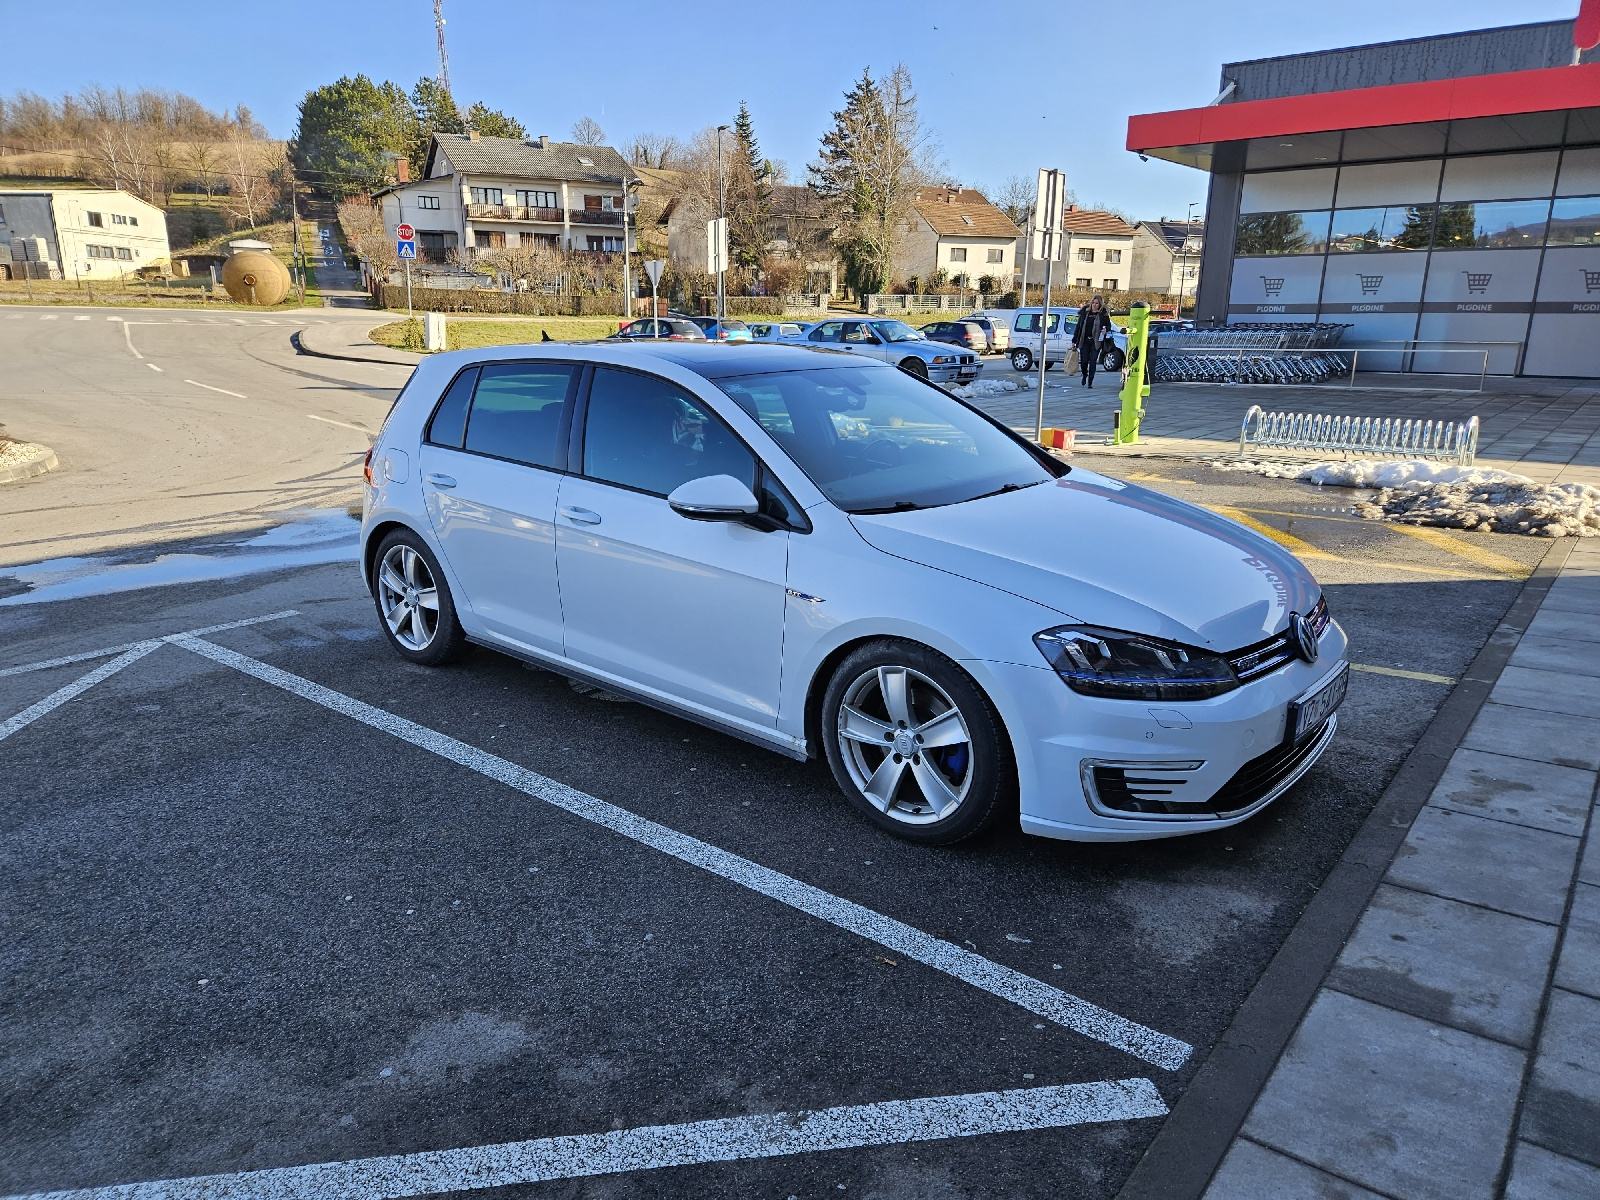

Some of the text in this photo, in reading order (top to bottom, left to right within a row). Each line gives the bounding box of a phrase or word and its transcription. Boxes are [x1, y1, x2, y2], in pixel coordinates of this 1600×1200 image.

[398, 228, 413, 237] STOP
[1256, 305, 1286, 313] PLODINE
[1351, 304, 1385, 312] PLODINE
